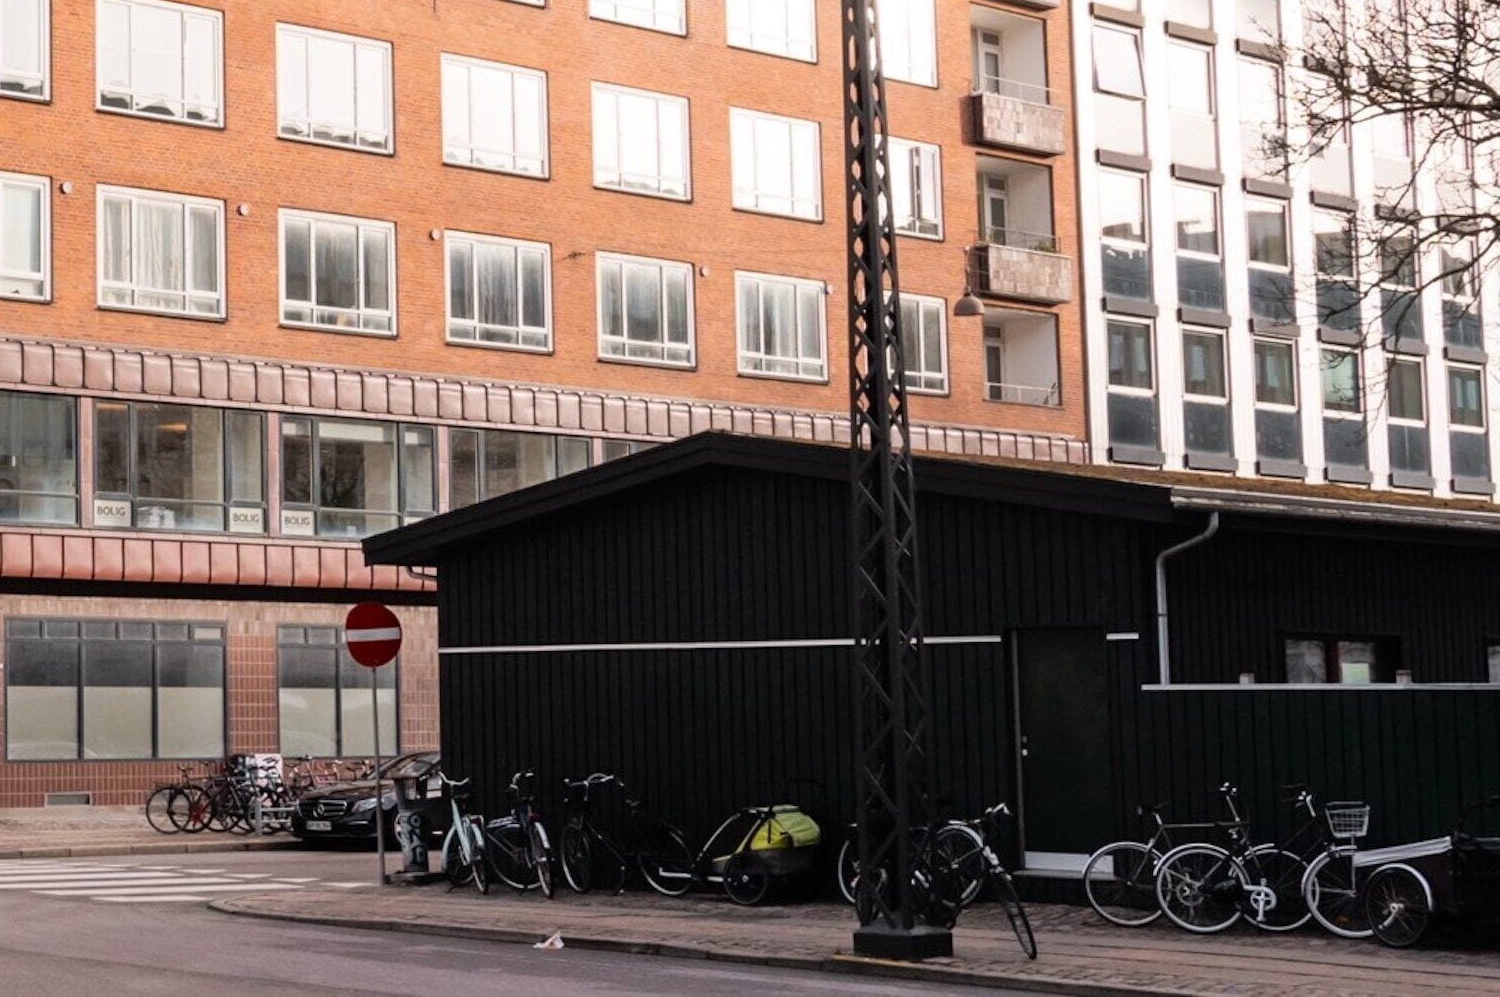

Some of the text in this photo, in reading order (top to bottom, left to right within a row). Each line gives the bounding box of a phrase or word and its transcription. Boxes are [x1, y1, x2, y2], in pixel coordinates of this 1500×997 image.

[97, 506, 126, 516] BOLIG
[233, 513, 260, 522] BOLIG
[284, 516, 310, 526] BOLIG
